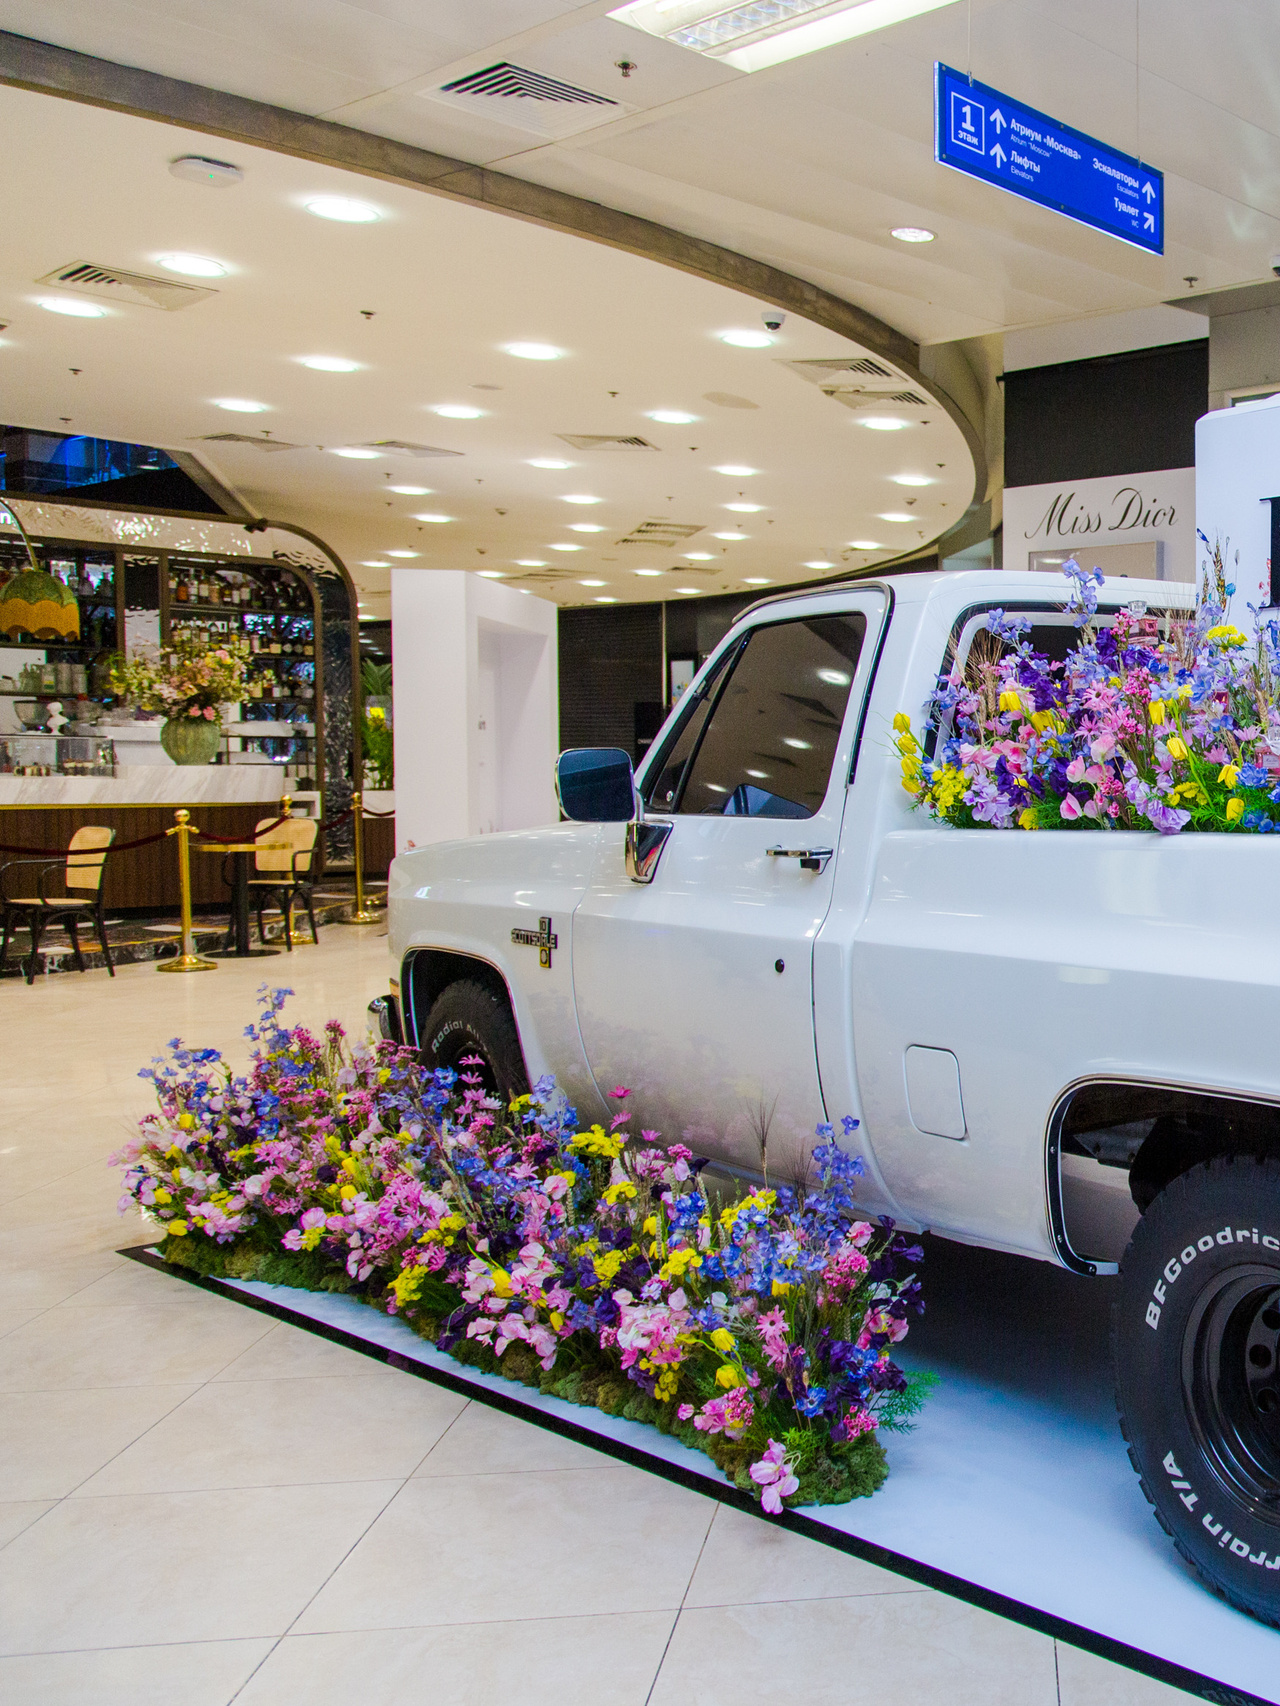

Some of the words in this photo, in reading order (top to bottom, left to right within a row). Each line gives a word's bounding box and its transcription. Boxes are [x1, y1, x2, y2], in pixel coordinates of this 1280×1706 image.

[962, 105, 975, 132] 1
[1011, 118, 1042, 143] Атриум
[958, 130, 979, 146] этаж
[1011, 134, 1028, 148] Atrium
[1011, 150, 1041, 174] Лифты
[1011, 165, 1034, 183] Elevators
[1092, 157, 1140, 189] Эскалаторы
[1116, 183, 1140, 200] Escalators
[1113, 197, 1140, 217] Туалет
[1024, 492, 1102, 539] Miss
[1108, 487, 1179, 531] Dior
[431, 1020, 464, 1053] Radial
[1162, 1450, 1199, 1513] T/A
